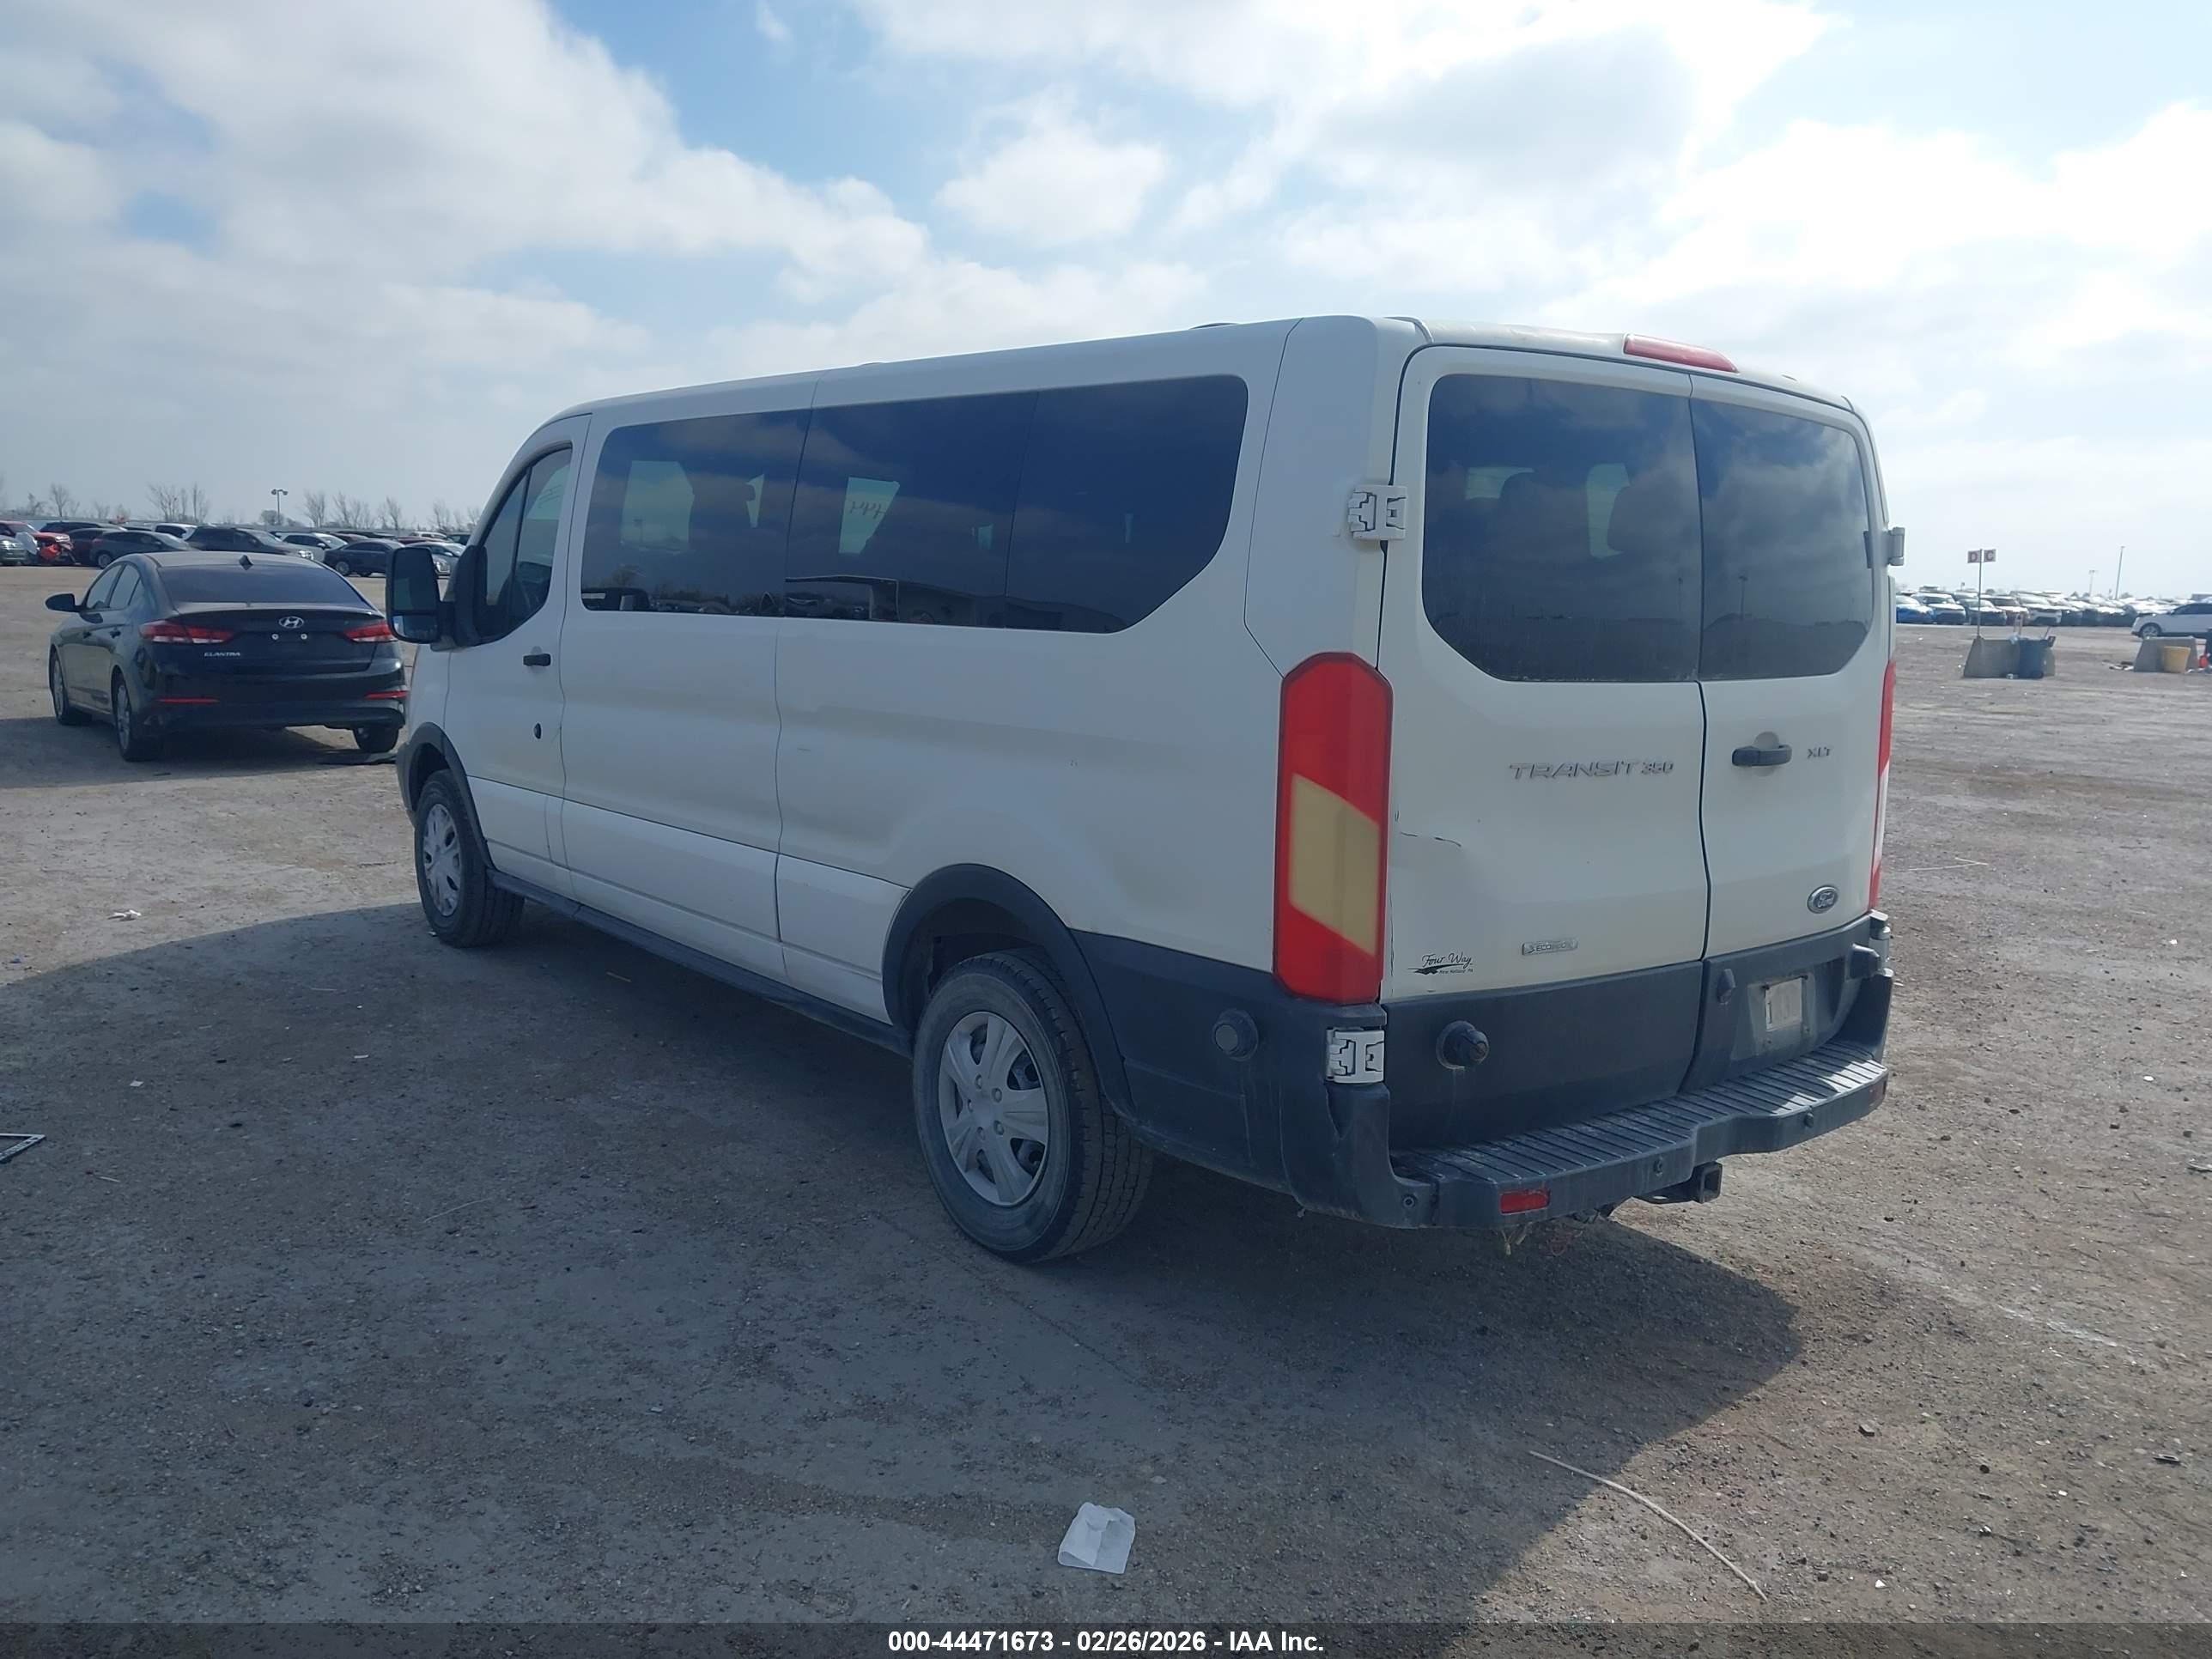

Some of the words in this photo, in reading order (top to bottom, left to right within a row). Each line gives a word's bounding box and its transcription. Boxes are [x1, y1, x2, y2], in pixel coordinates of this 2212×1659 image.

[1807, 746, 1834, 759] XLT
[1510, 761, 1639, 780] TRANSIT
[1641, 761, 1674, 775] 350
[1421, 953, 1445, 968] Four
[1448, 951, 1472, 969] Way
